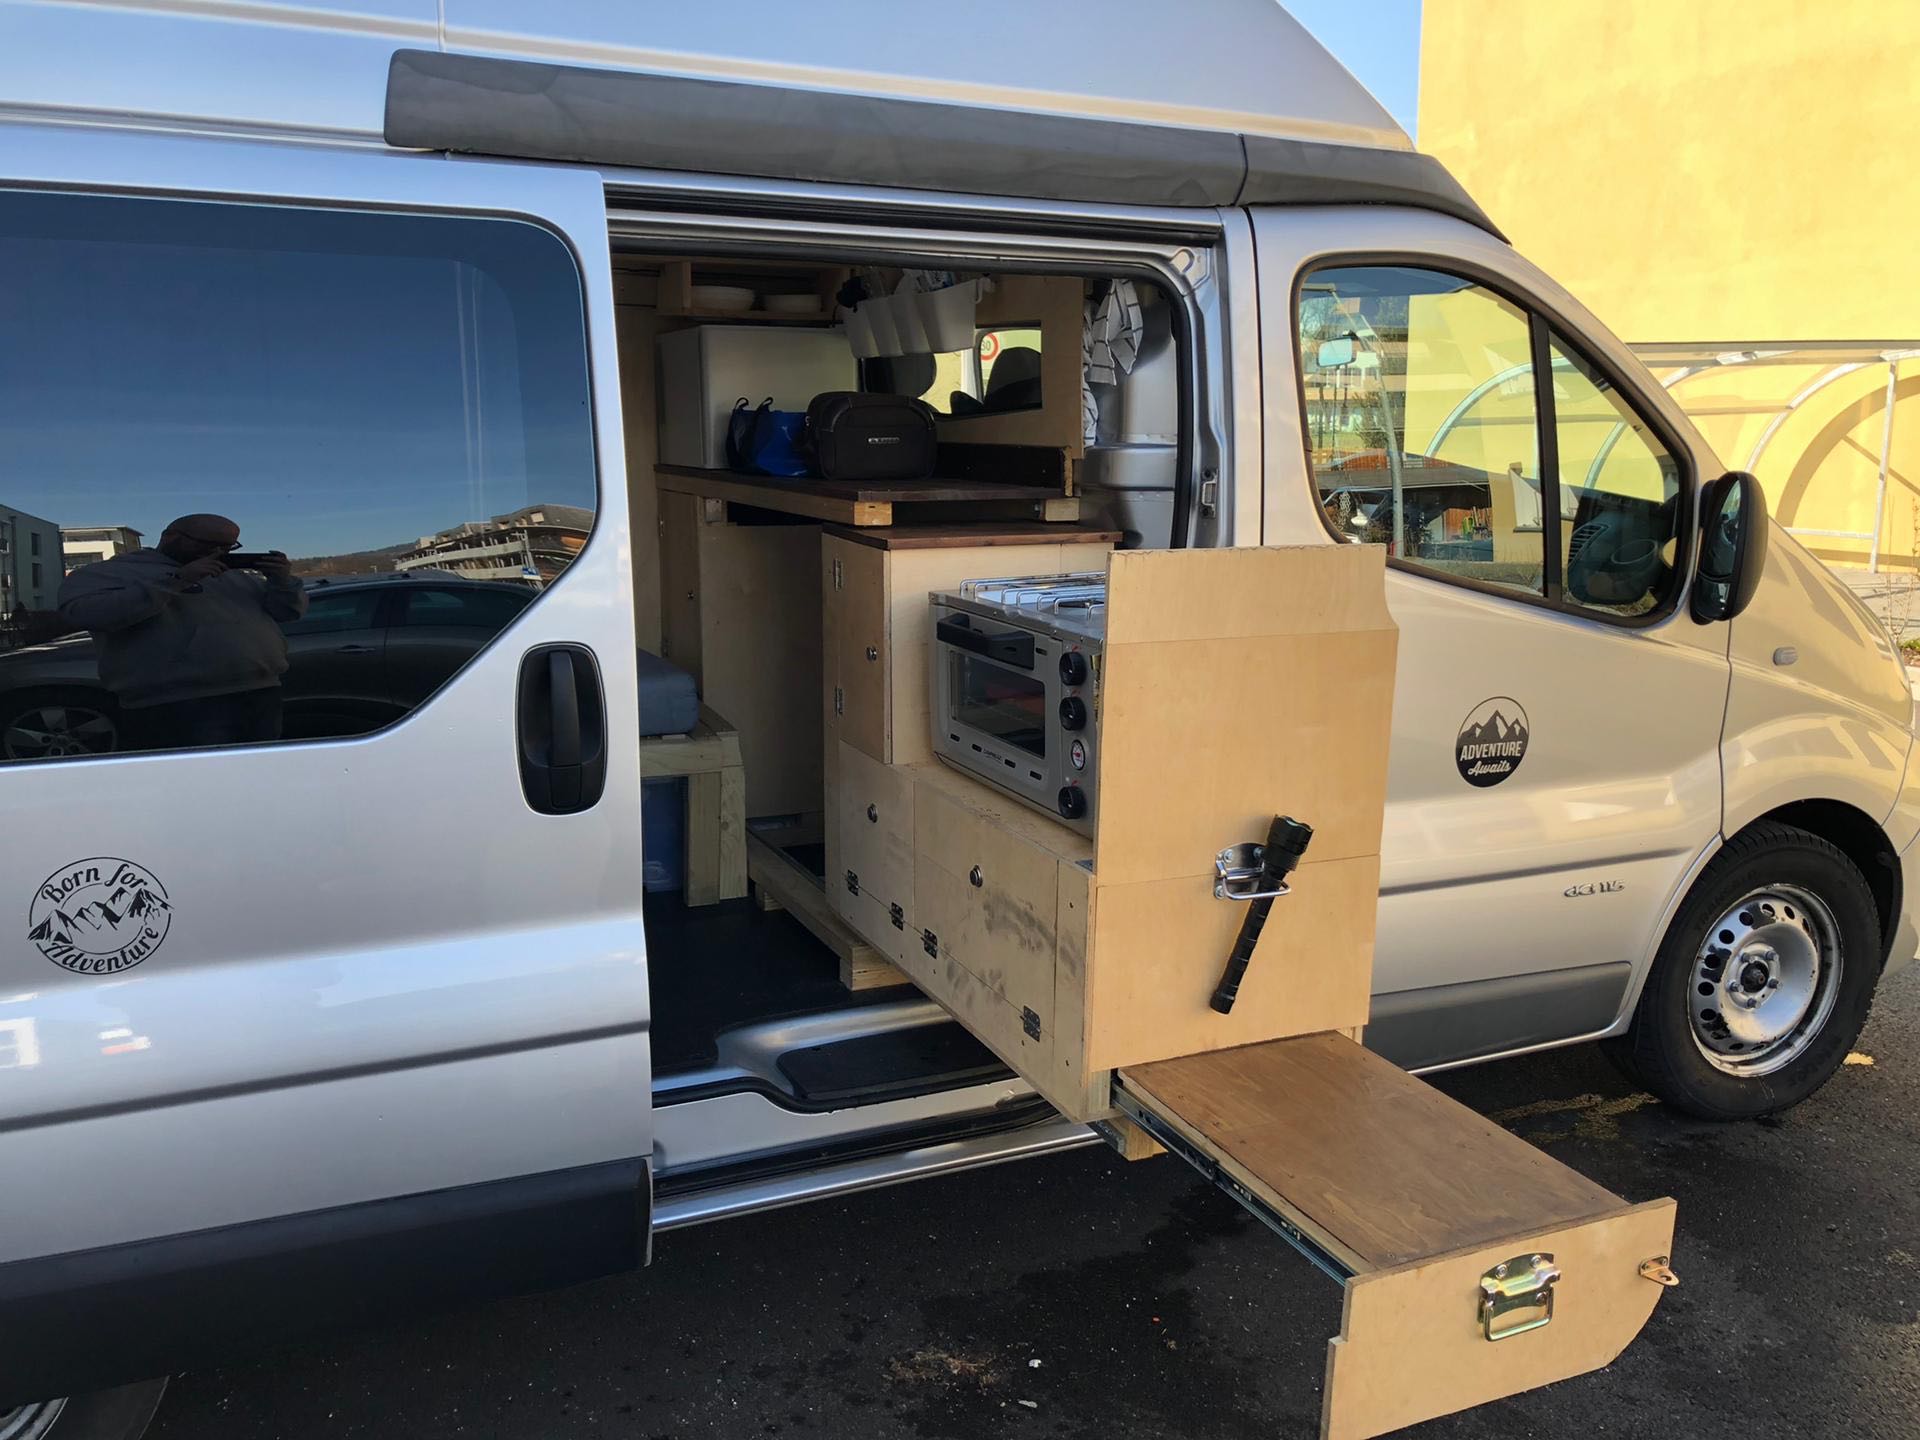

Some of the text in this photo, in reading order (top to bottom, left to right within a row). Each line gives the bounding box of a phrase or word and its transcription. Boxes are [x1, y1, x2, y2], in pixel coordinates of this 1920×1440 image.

[1460, 741, 1523, 761] ADVENTURE
[1467, 760, 1511, 776] Awaits
[41, 863, 148, 904] Born for
[43, 927, 159, 972] Adventure
